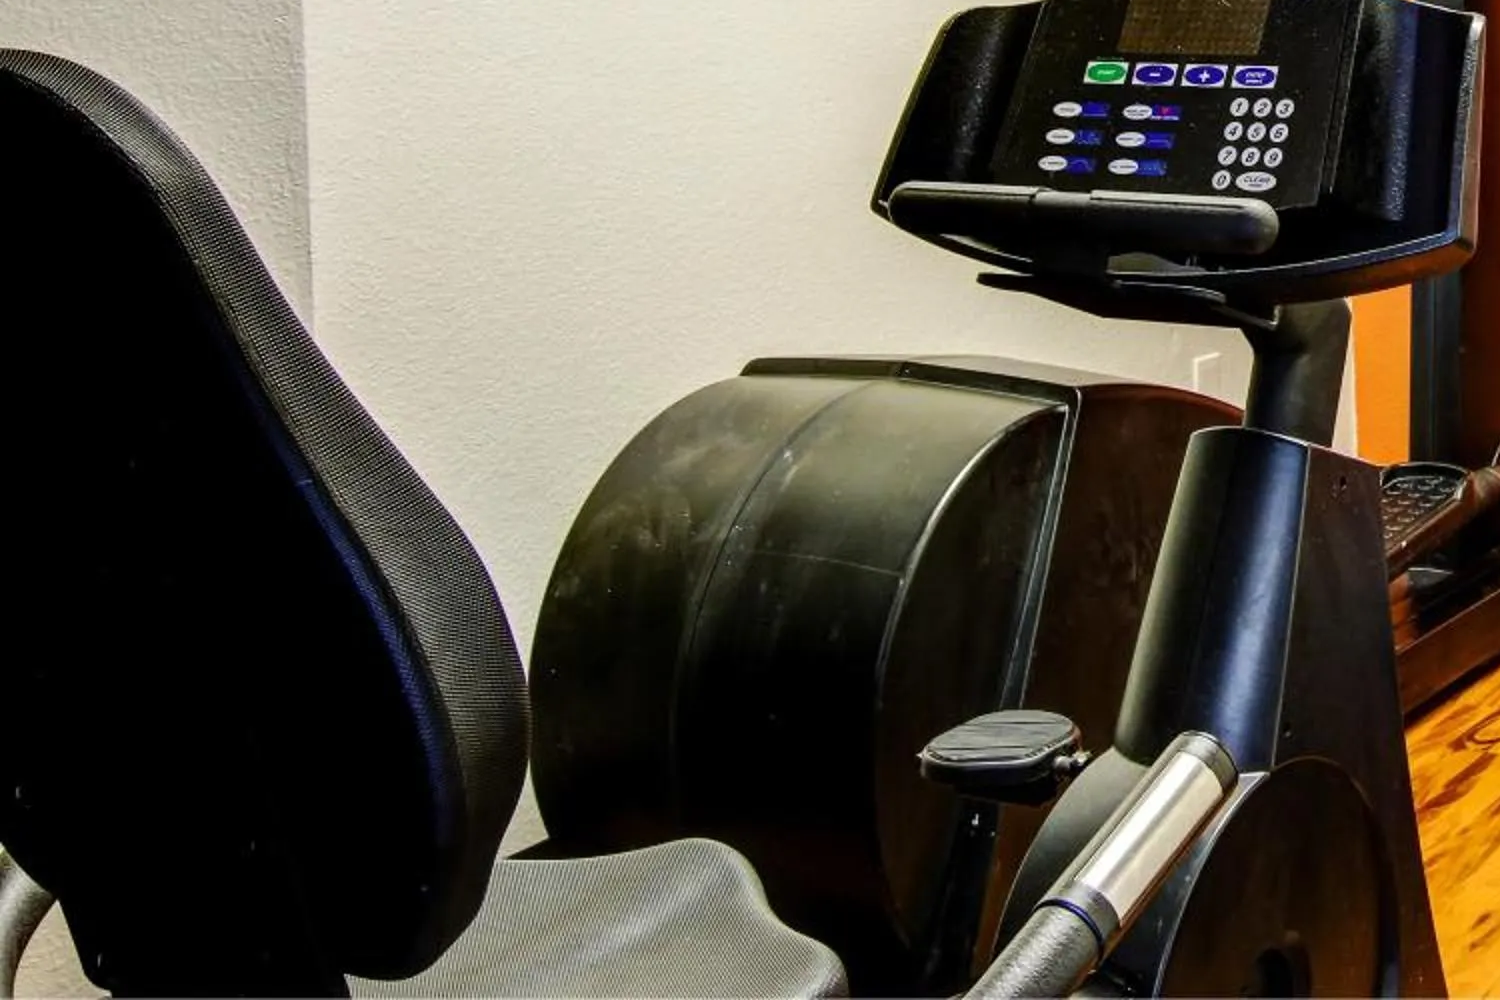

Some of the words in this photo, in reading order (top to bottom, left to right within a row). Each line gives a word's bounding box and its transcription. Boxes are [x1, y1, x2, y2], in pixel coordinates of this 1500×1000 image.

[1235, 101, 1243, 114] 1
[1257, 102, 1268, 115] 2
[1279, 102, 1291, 116] 3
[1228, 124, 1238, 137] 4
[1251, 125, 1262, 139] 5
[1274, 126, 1284, 139] 6
[1222, 149, 1232, 162] 7
[1246, 150, 1255, 163] 8
[1269, 151, 1279, 164] 9
[1217, 173, 1226, 187] 0
